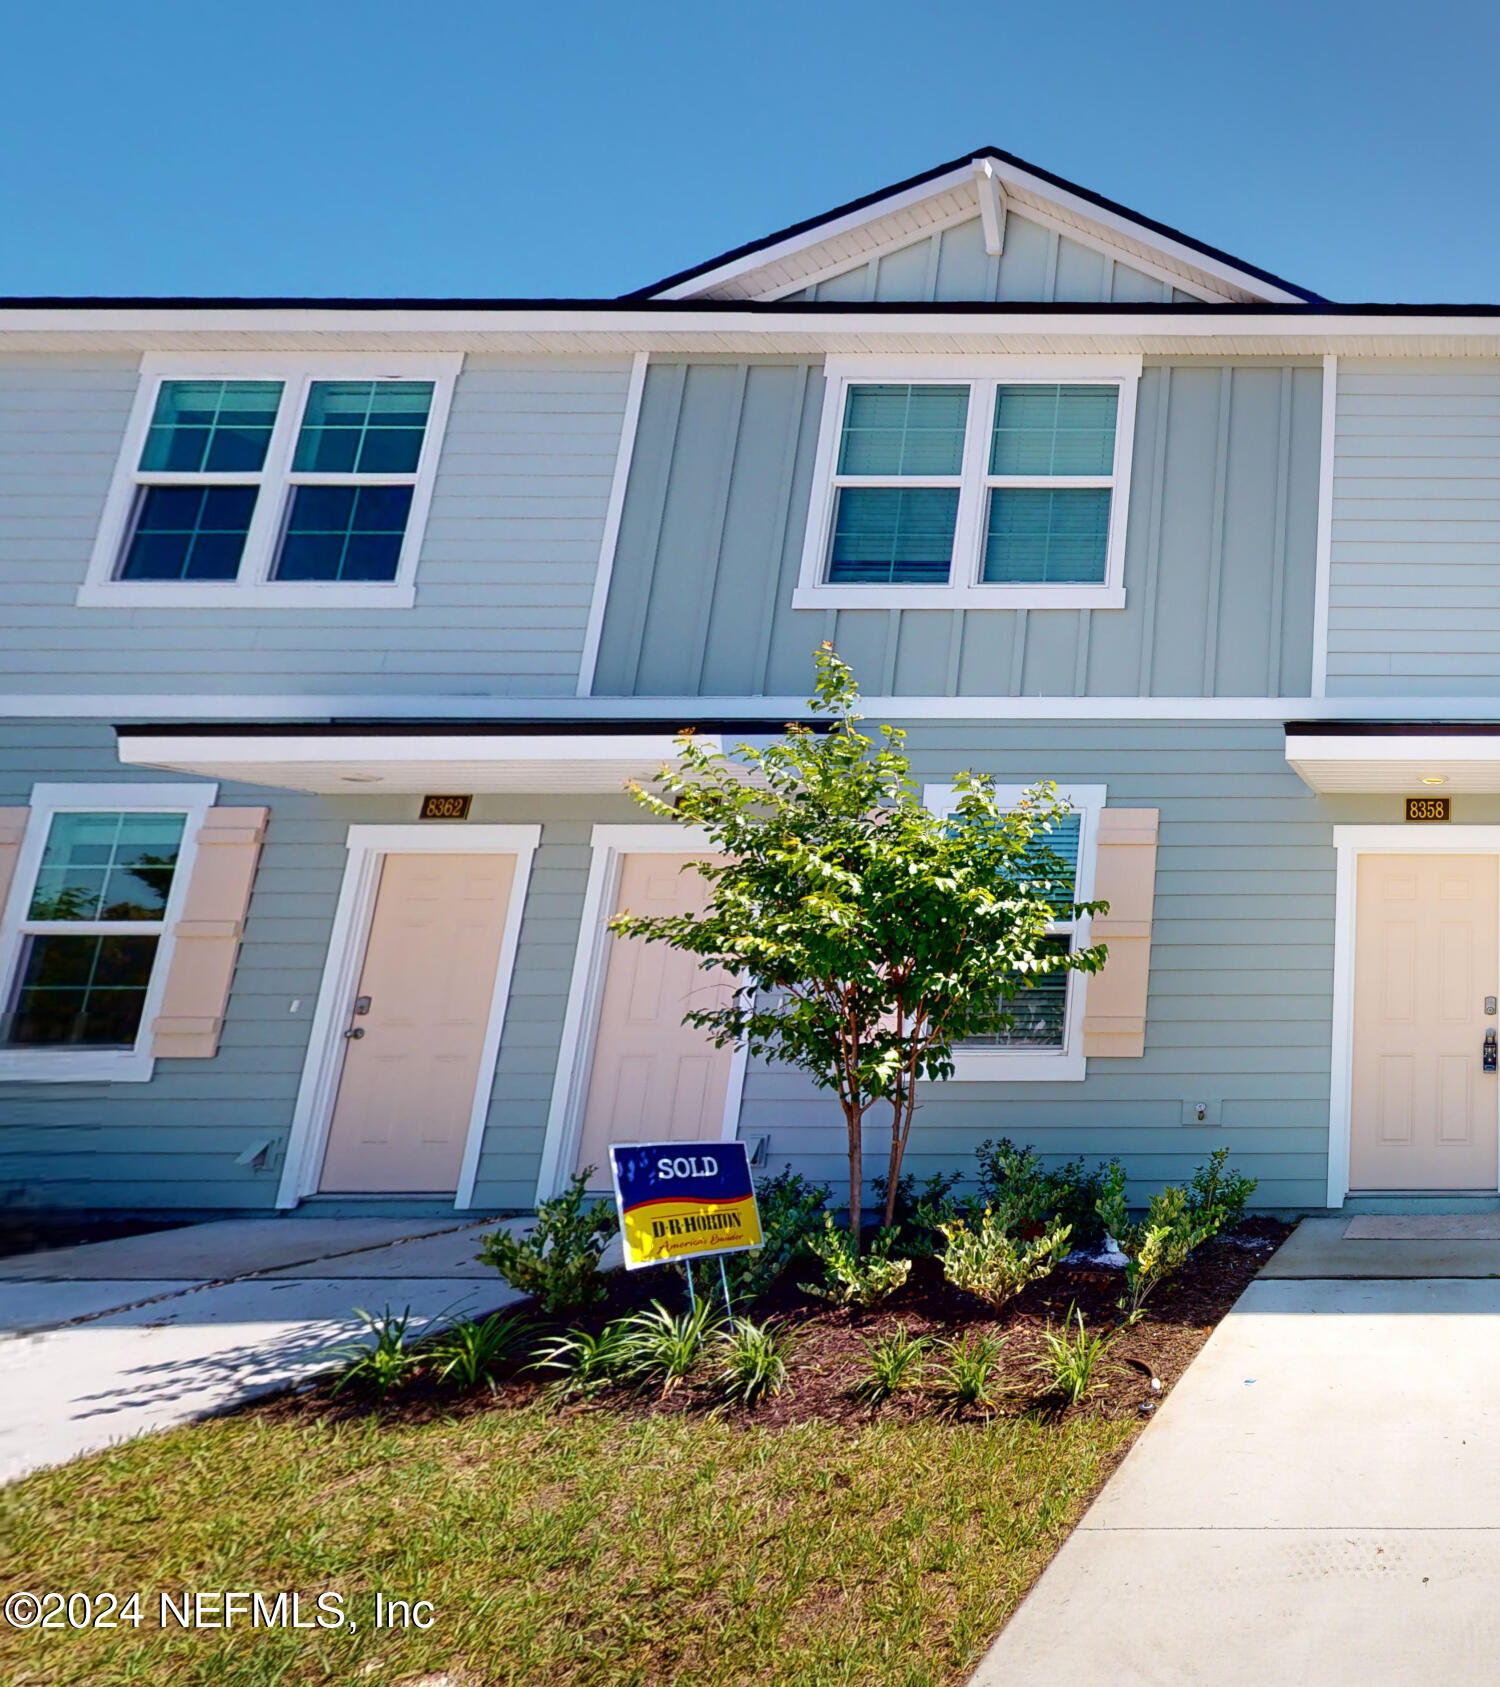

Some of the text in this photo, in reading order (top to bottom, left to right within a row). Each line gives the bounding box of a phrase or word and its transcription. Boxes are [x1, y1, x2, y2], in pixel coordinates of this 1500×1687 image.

[426, 798, 463, 816] 8362
[1410, 801, 1444, 818] 8358
[657, 1156, 719, 1180] SOLD
